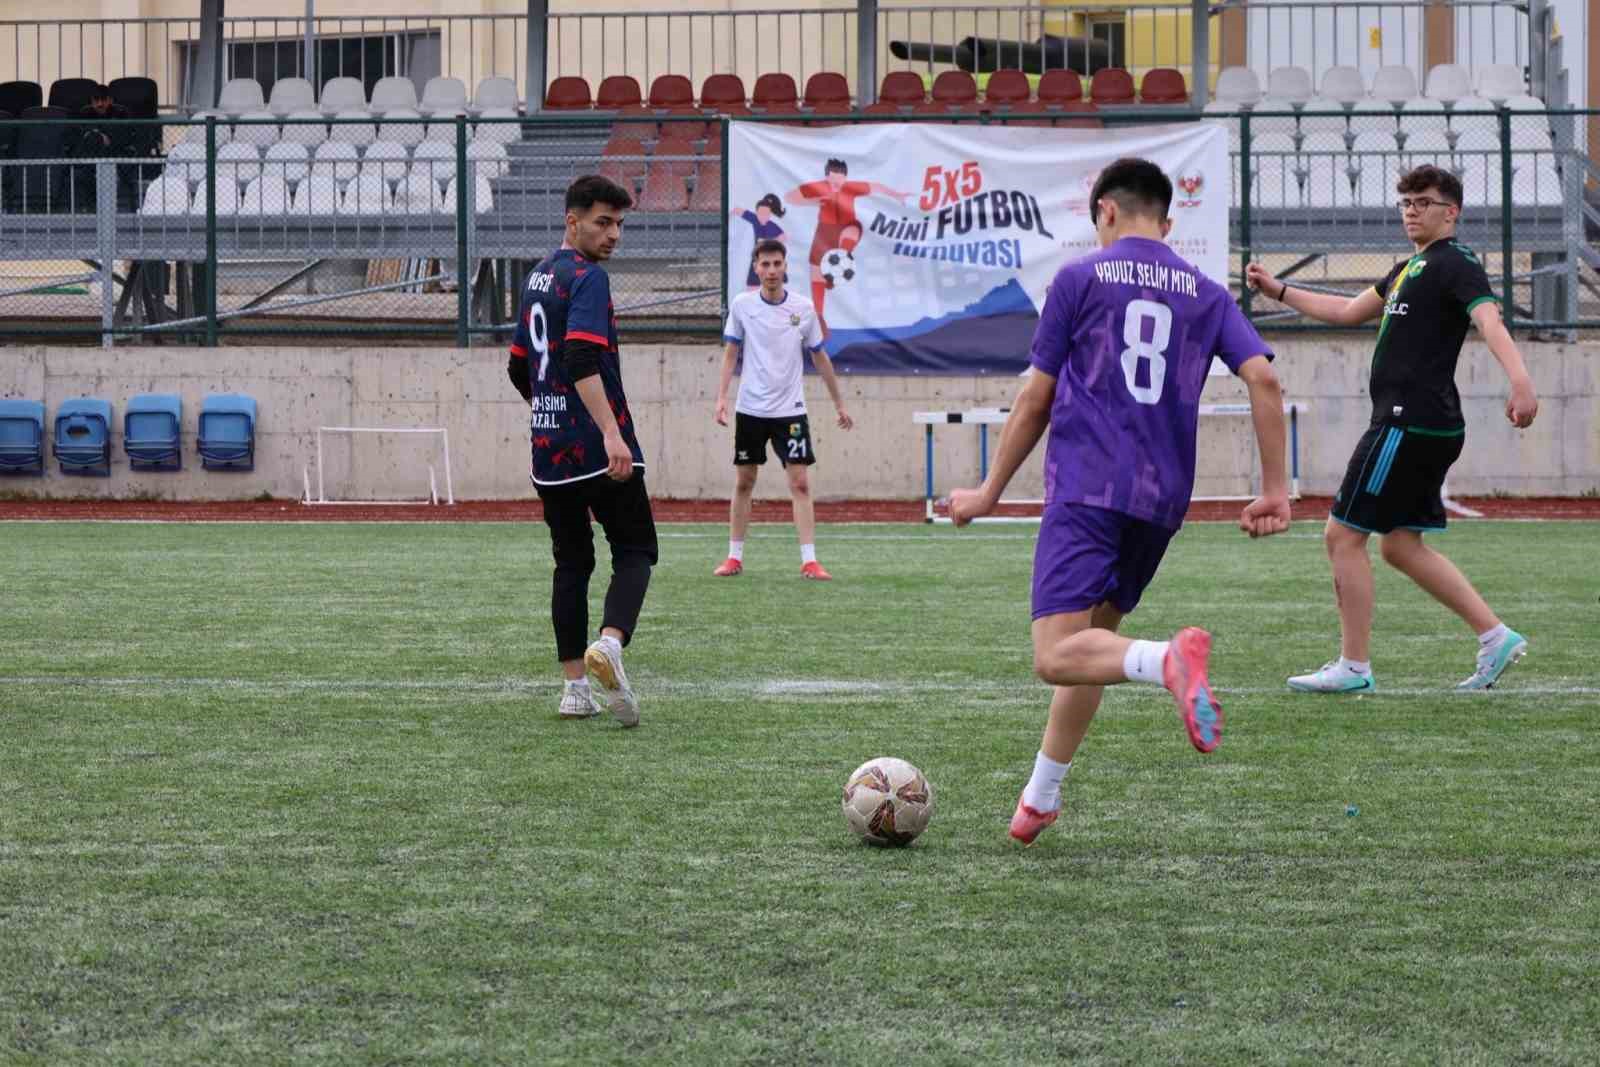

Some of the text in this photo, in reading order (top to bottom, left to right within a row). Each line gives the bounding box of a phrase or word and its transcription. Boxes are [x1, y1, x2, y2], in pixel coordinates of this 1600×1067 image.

[919, 161, 982, 211] 5x5
[936, 189, 1054, 240] FUTBOL
[1095, 260, 1198, 297] YAVUZ SELİM MTAL
[529, 301, 549, 382] 9
[1120, 299, 1172, 405] 8
[787, 439, 807, 459] 21
